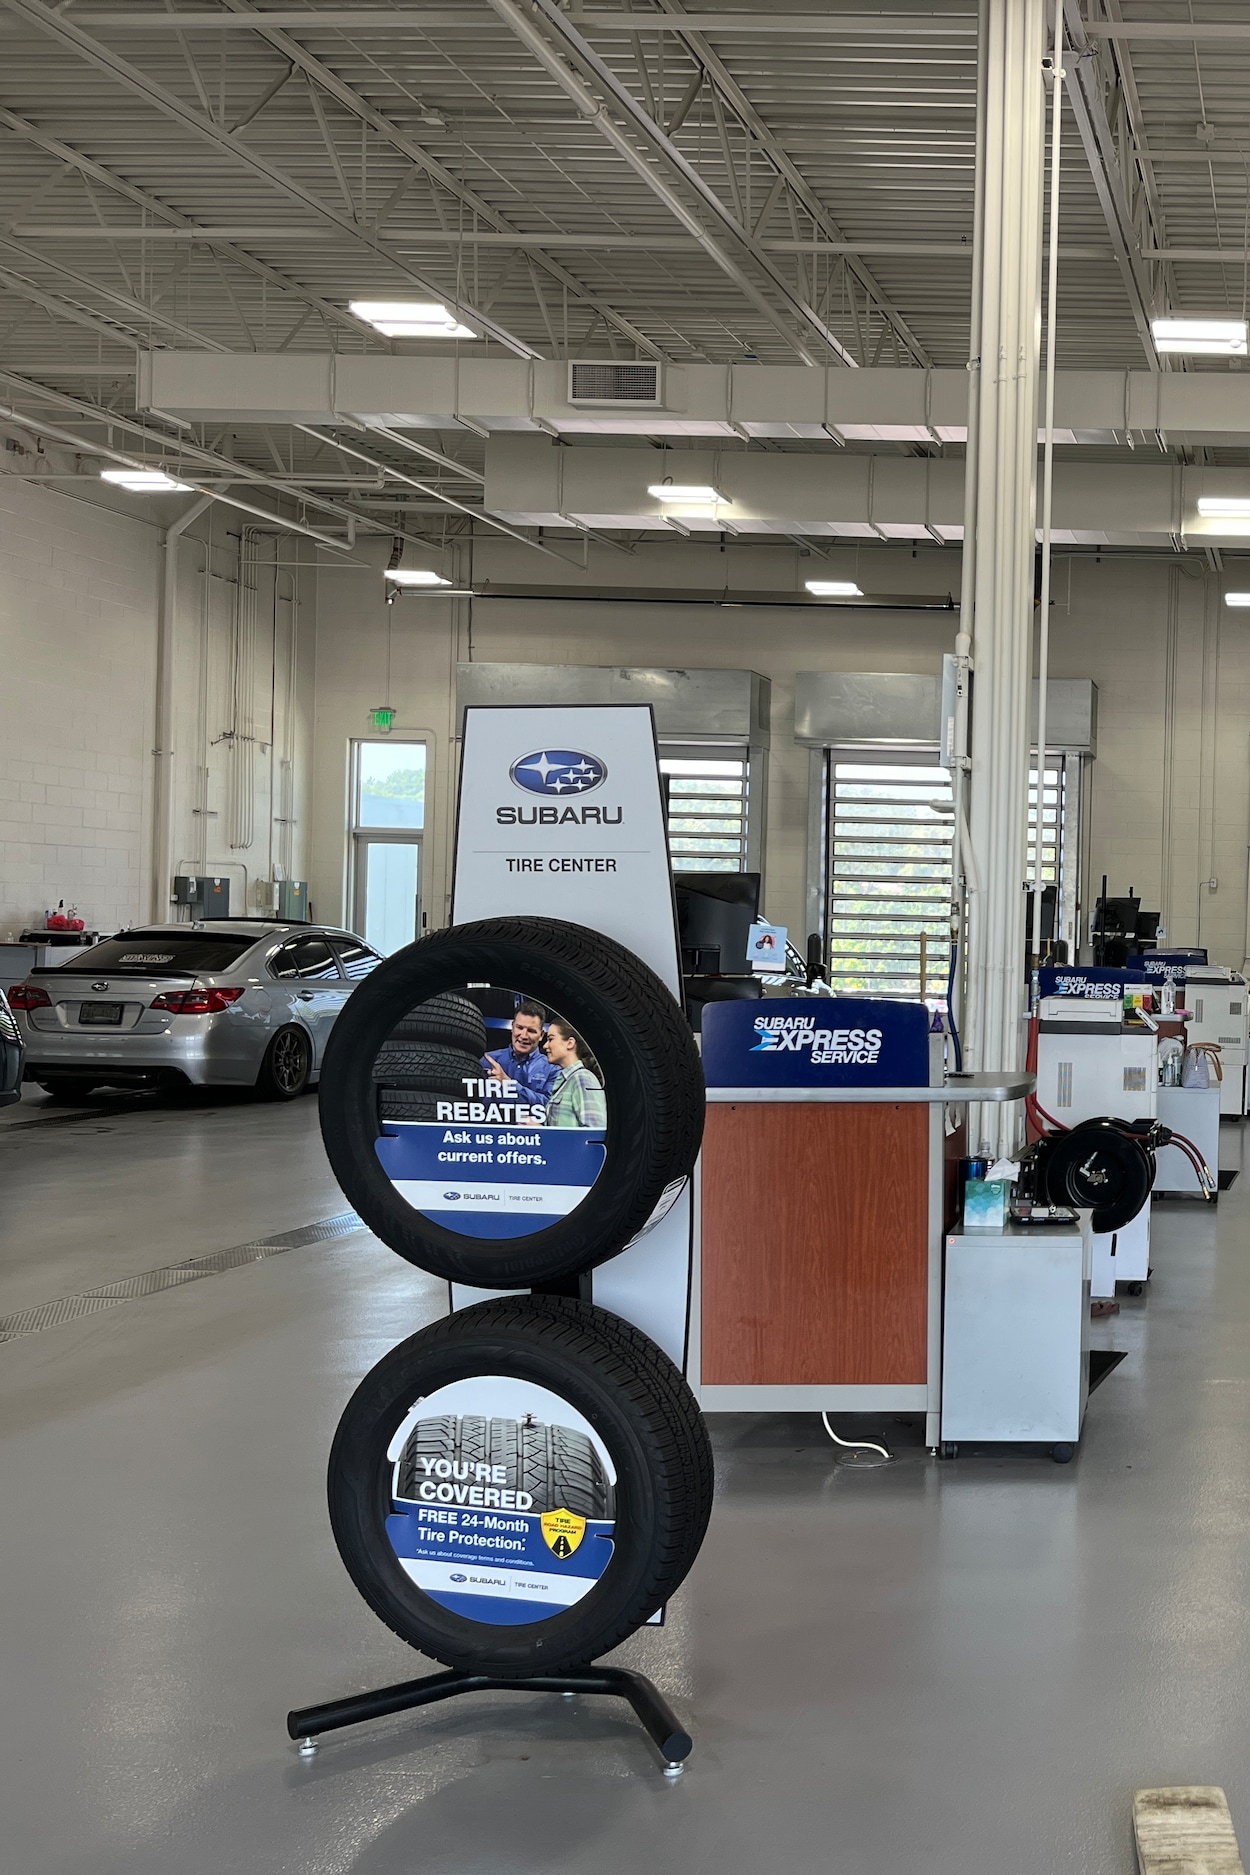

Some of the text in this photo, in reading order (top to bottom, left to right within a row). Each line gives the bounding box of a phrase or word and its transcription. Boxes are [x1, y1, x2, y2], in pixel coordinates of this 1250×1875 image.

[496, 806, 623, 825] SUBARU
[506, 858, 617, 872] TIRE CENTER
[1055, 976, 1087, 984] SUBARU
[1053, 983, 1121, 995] EXPRESS
[753, 1016, 815, 1030] SUBARU
[750, 1029, 883, 1051] EXPRESS
[810, 1050, 879, 1064] SERVICE
[461, 1078, 518, 1099] TIRE
[436, 1102, 547, 1123] REBATES
[443, 1131, 541, 1146] Ask us about
[437, 1151, 547, 1165] current offers.
[463, 1193, 500, 1201] SUBARU
[420, 1457, 507, 1485] YOU'RE
[419, 1481, 533, 1511] COVERED
[418, 1508, 529, 1533] FREE 24-Month
[555, 1517, 571, 1525] TIRE
[417, 1527, 446, 1542] Tire
[549, 1527, 577, 1535] PROGRAM
[453, 1553, 477, 1561] coverage
[469, 1577, 506, 1586] SUBARU
